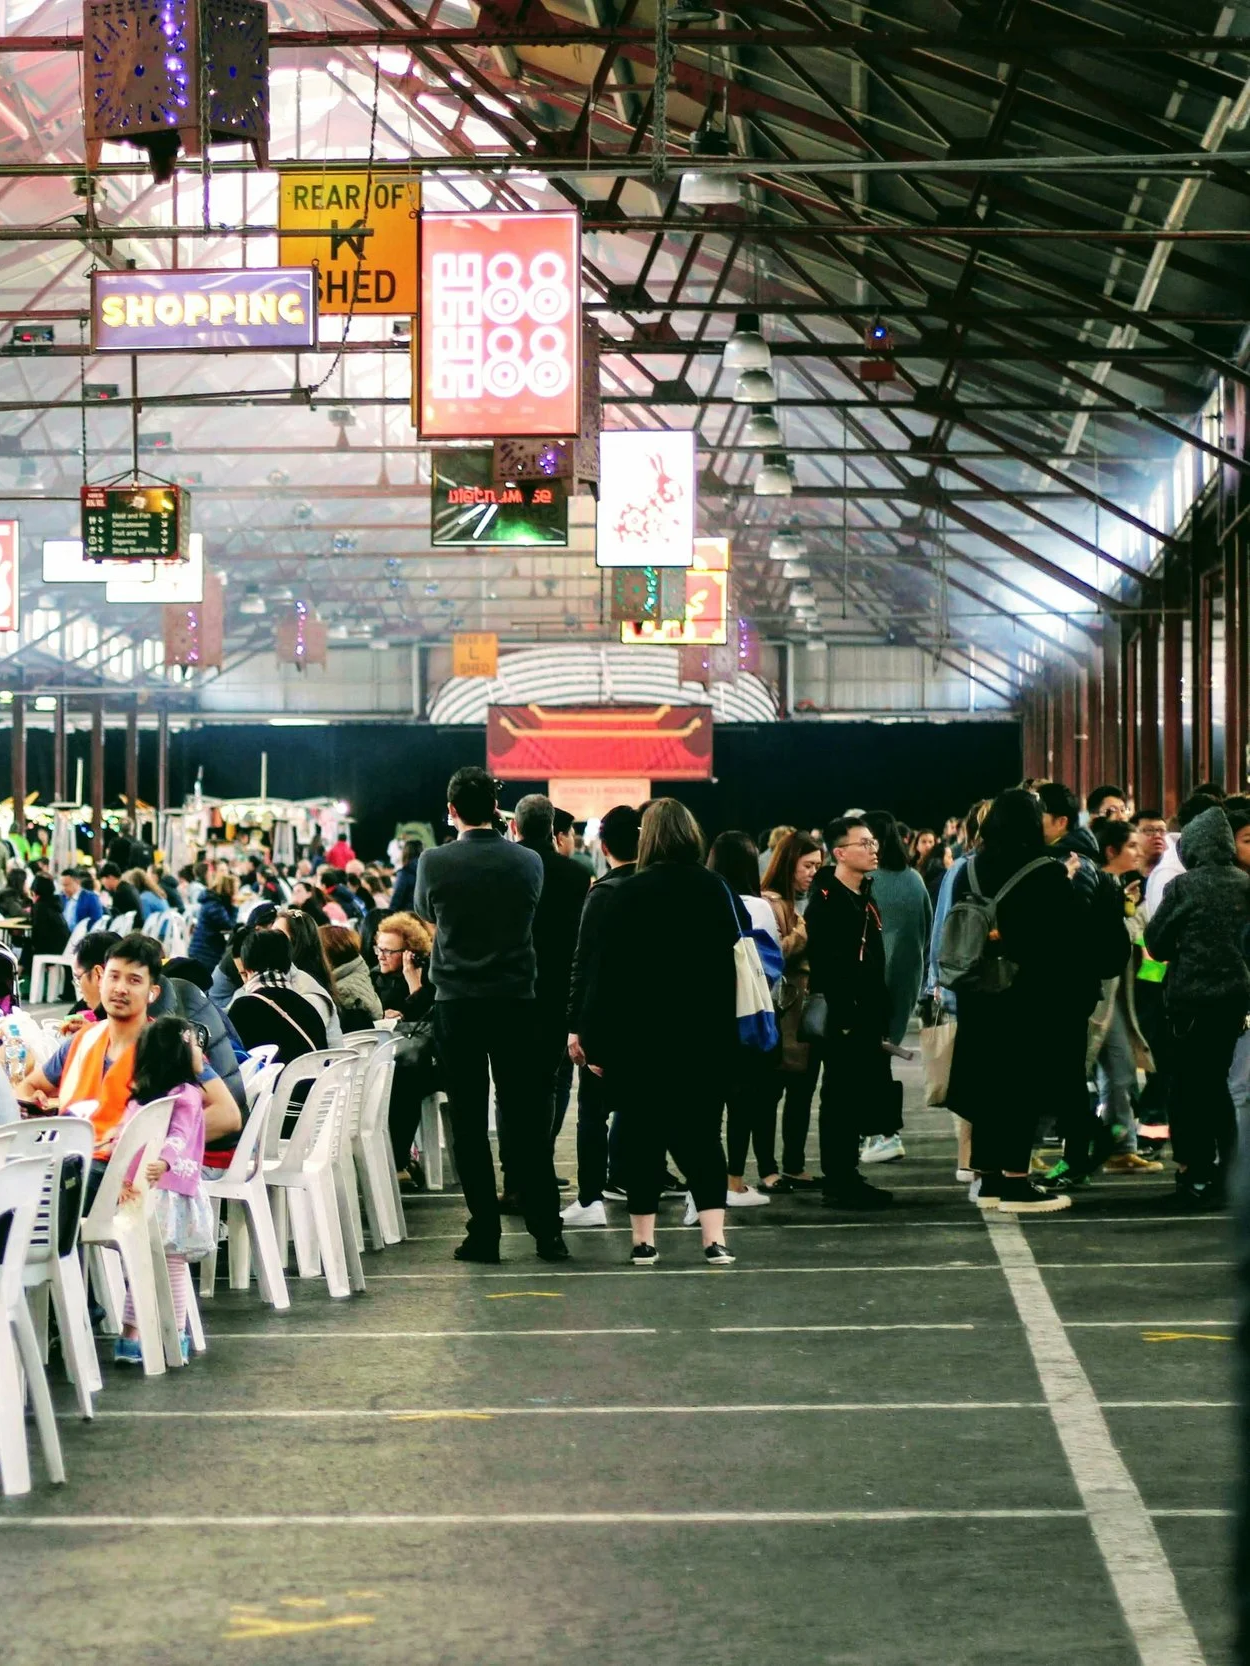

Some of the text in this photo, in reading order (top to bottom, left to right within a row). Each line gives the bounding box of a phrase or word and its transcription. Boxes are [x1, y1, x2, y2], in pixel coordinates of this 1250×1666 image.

[294, 184, 405, 210] REAR OF
[330, 219, 367, 261] K
[318, 270, 397, 303] HED
[101, 292, 306, 328] SHOPPING
